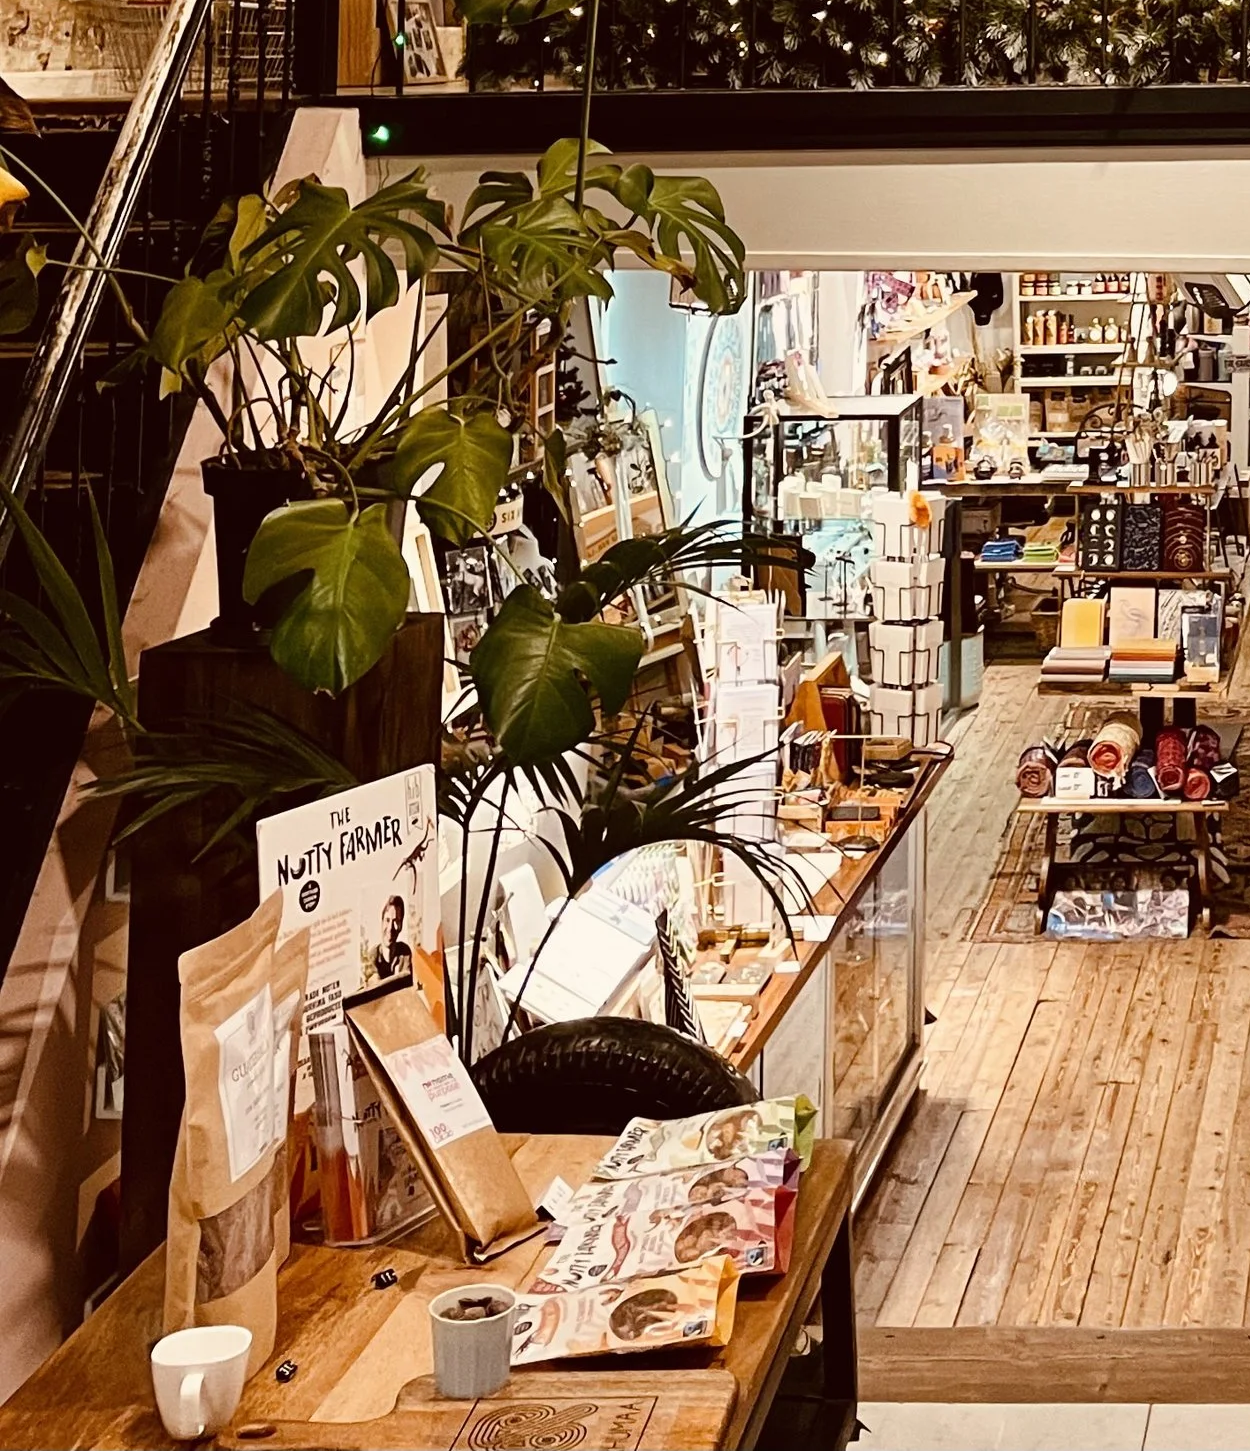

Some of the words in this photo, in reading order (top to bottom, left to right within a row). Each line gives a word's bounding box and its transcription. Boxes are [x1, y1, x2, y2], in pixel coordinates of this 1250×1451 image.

[330, 807, 350, 829] THE
[278, 842, 332, 887] NUTTY
[340, 816, 402, 866] FARMER
